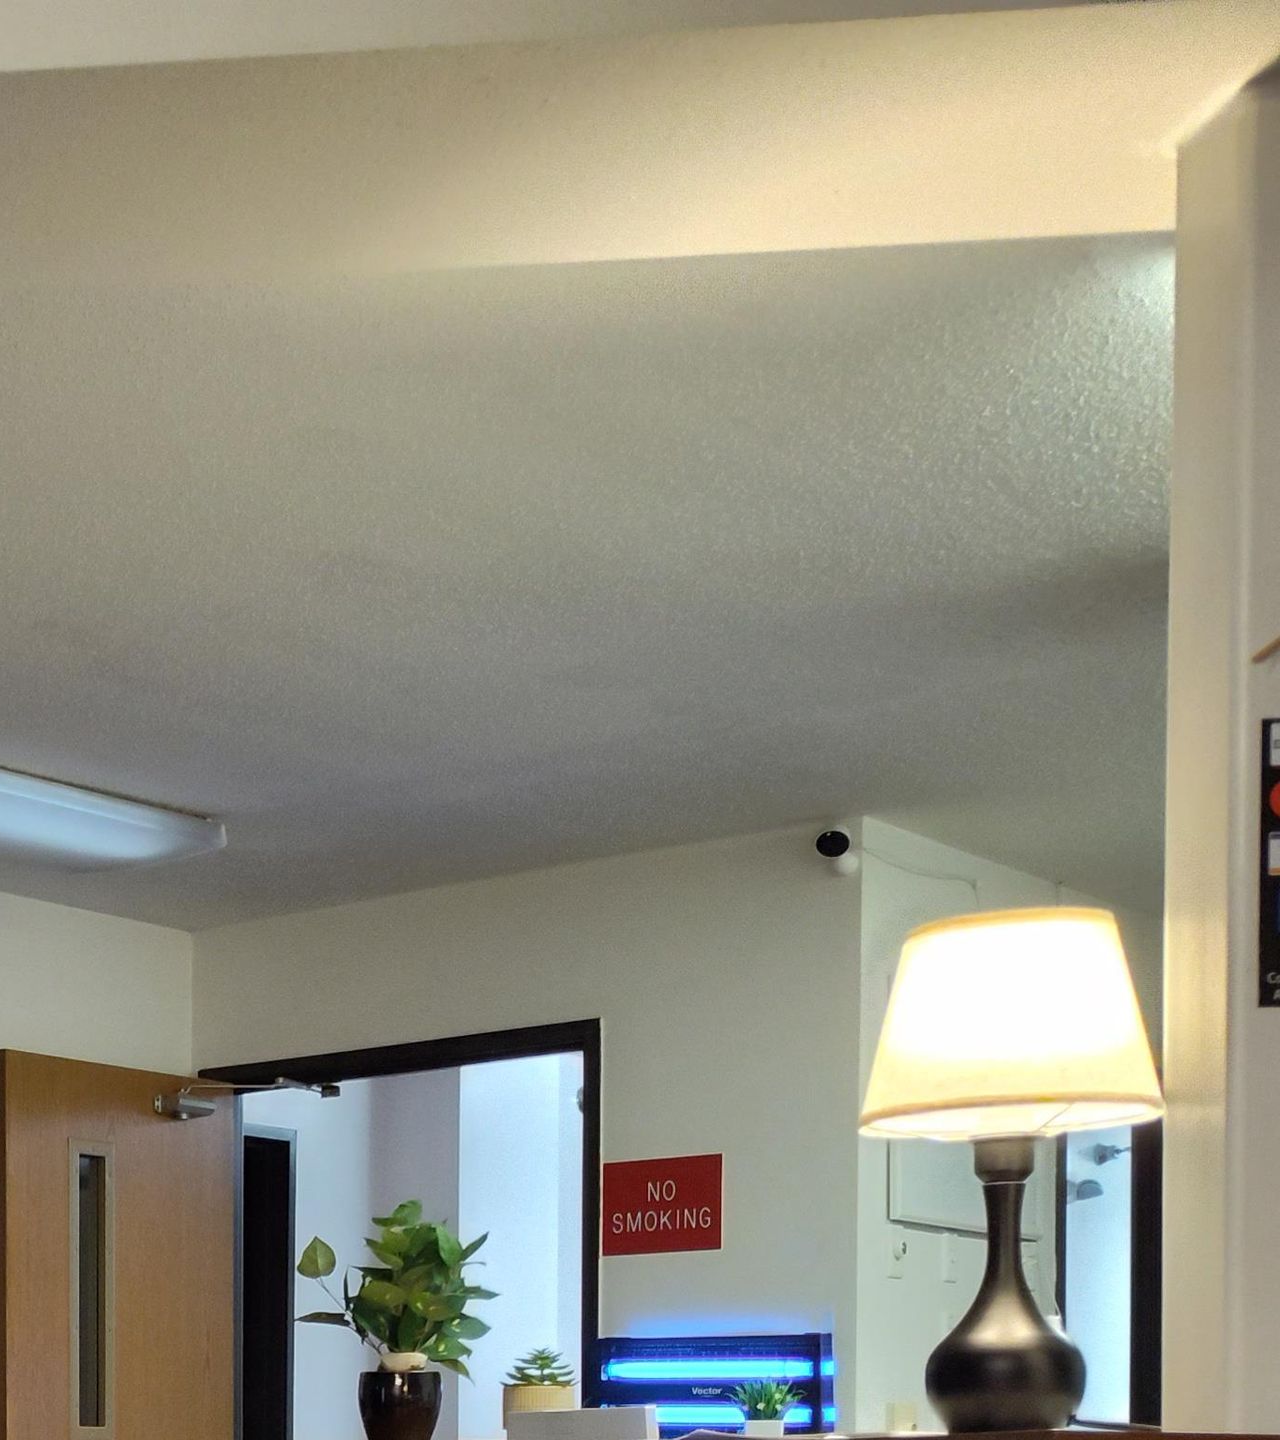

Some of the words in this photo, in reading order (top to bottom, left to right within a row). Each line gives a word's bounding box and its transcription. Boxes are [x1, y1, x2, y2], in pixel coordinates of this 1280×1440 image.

[646, 1179, 677, 1203] NO
[612, 1206, 712, 1235] SMOKING
[691, 1386, 723, 1396] Vector
